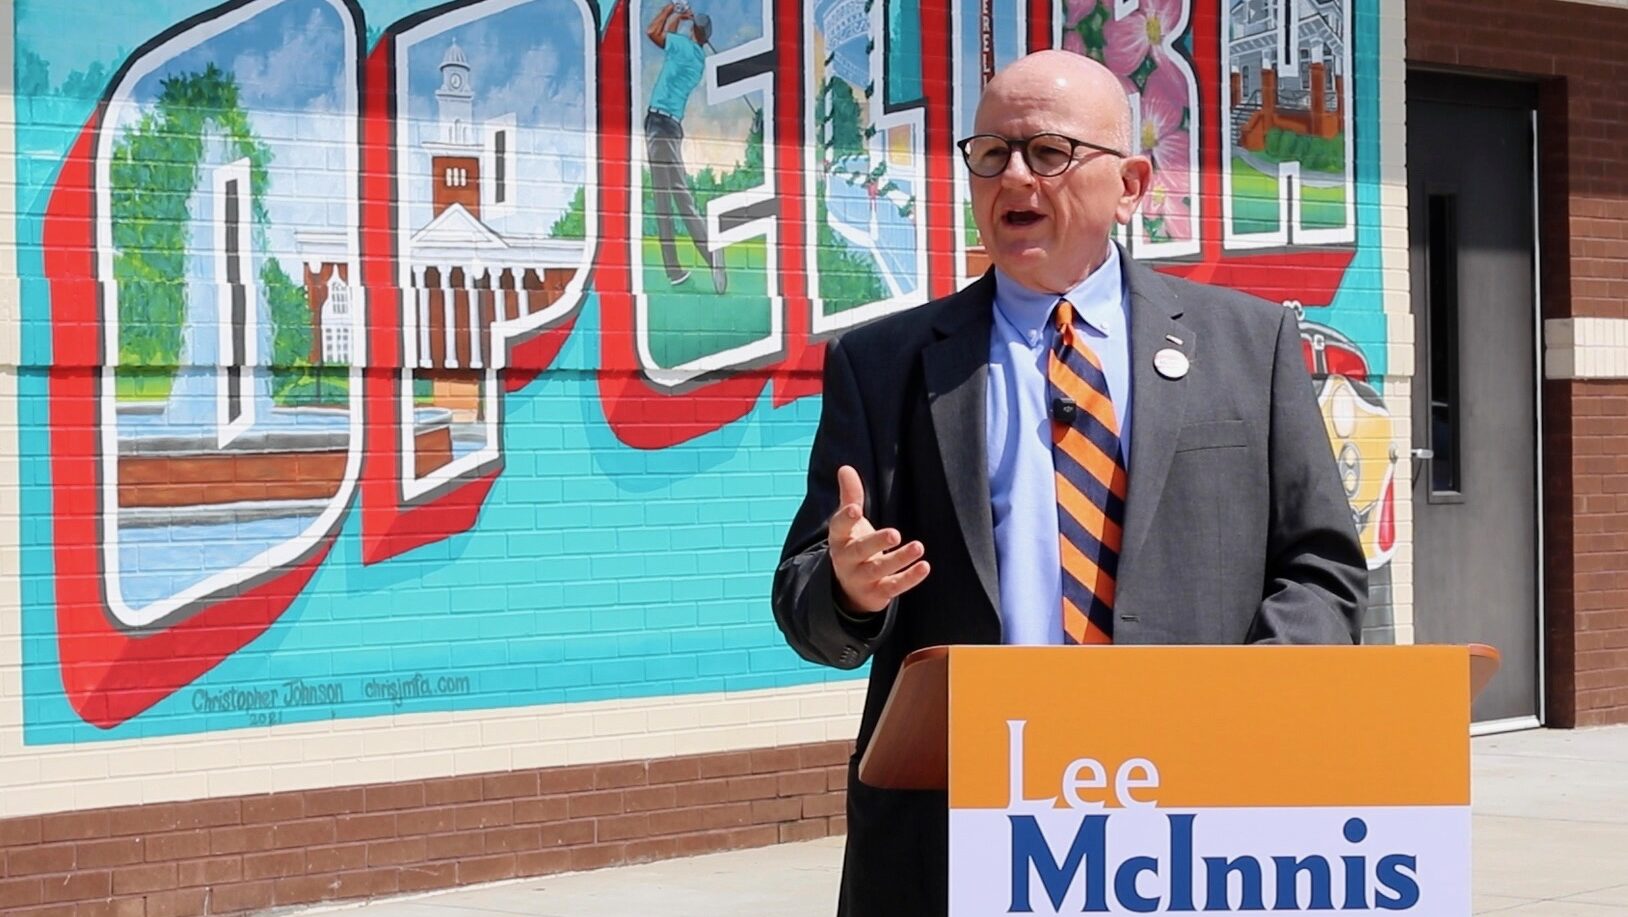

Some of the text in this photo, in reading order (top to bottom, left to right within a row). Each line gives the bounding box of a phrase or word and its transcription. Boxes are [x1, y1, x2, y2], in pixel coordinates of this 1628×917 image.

[92, 0, 1358, 635] OPELKA
[192, 672, 470, 712] Christopher Johnson chrisjmfa.com
[1006, 719, 1160, 810] Lee
[1007, 813, 1421, 914] McInnis
